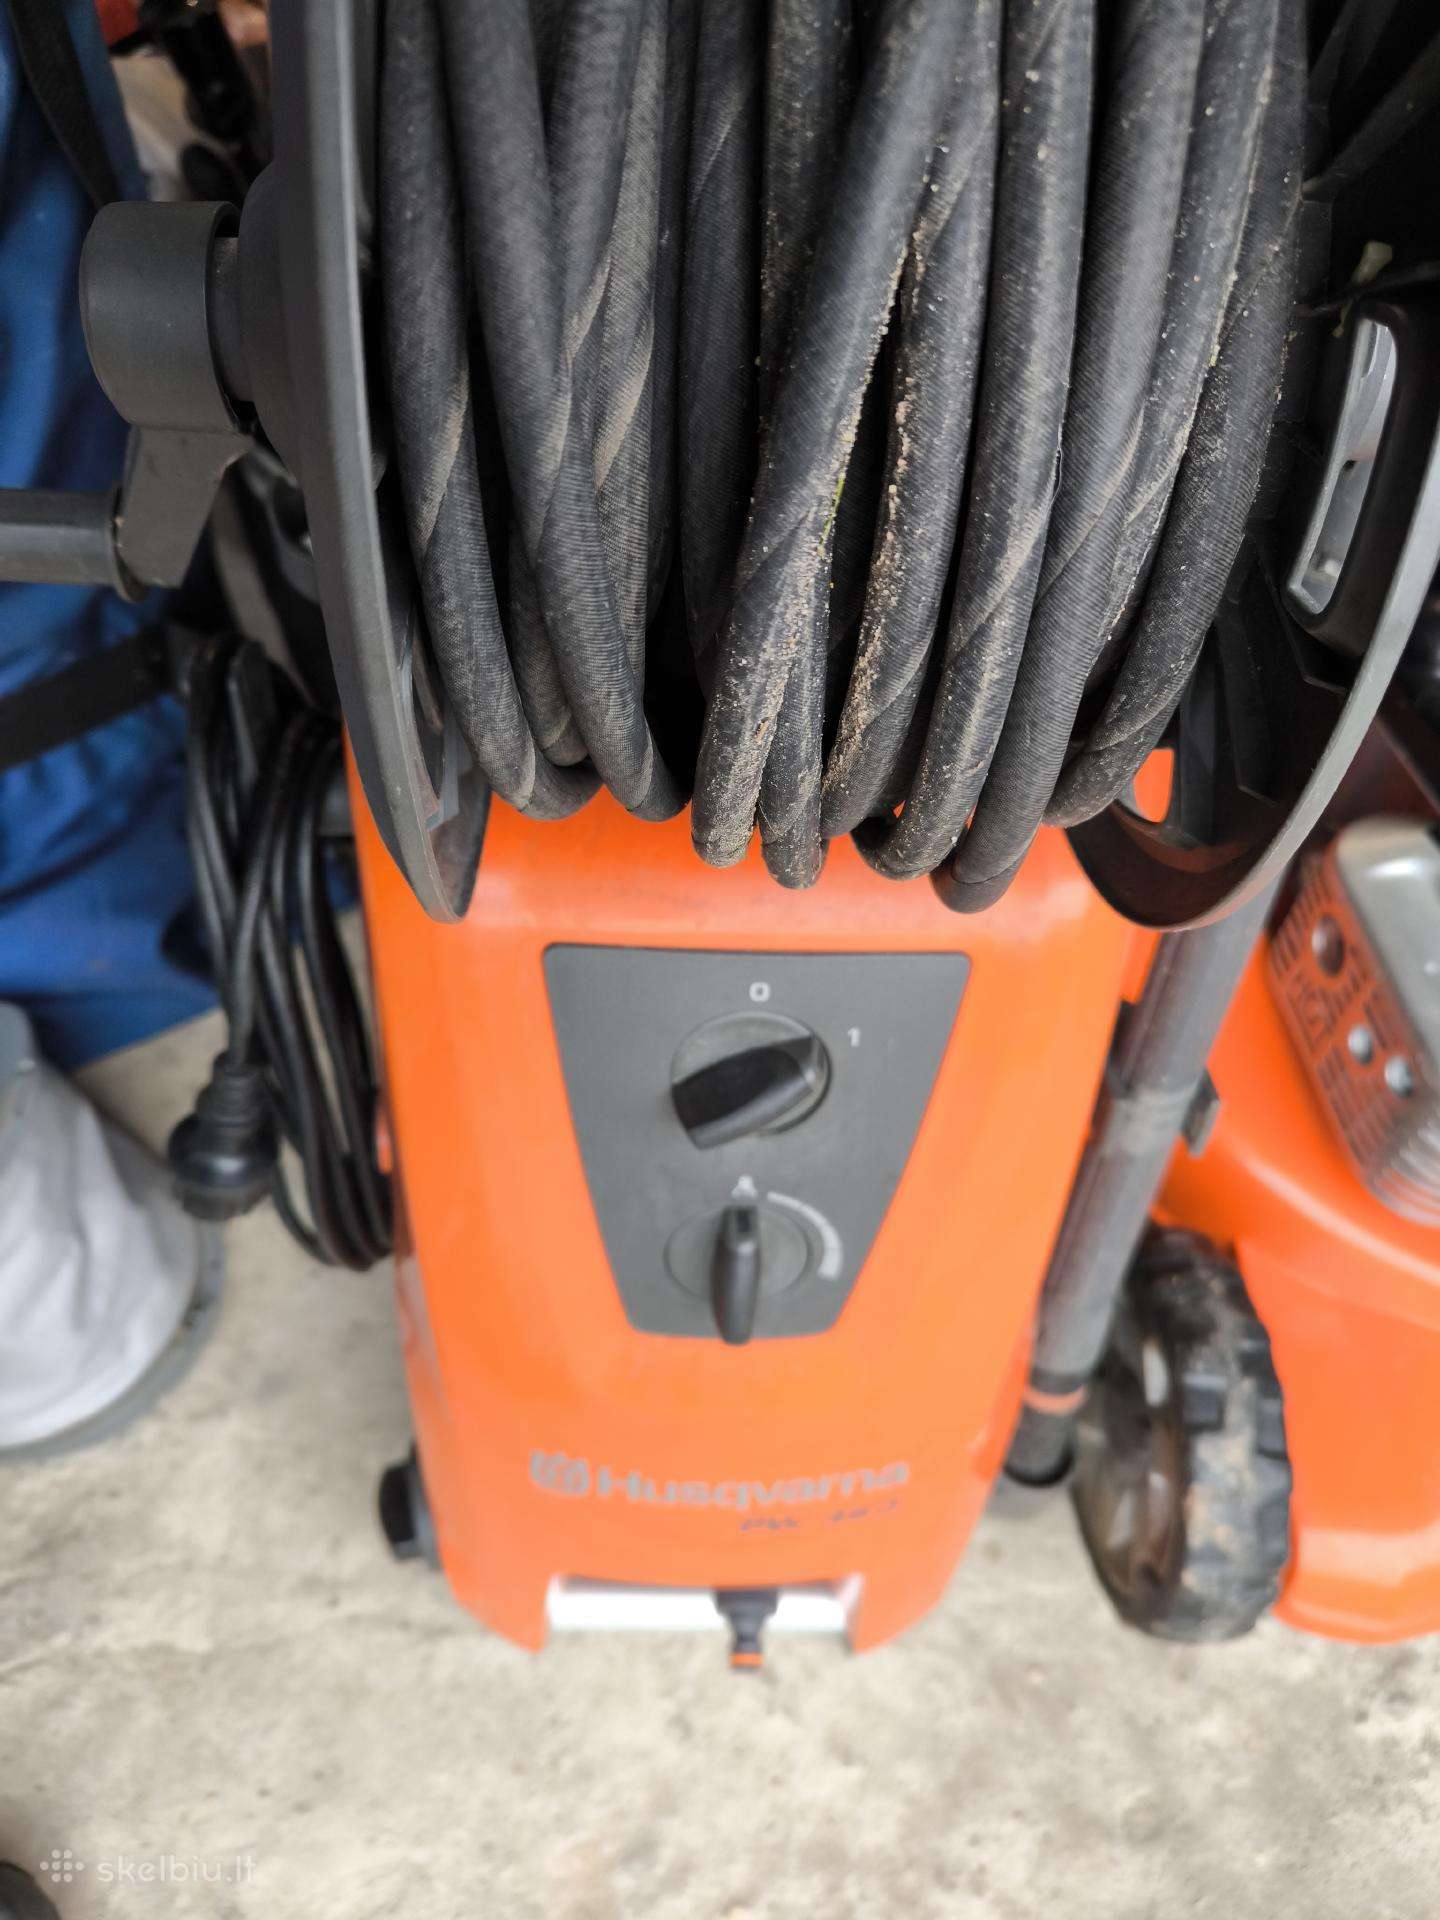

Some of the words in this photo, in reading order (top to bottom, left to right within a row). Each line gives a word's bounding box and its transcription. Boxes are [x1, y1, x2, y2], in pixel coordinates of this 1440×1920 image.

[749, 981, 770, 1001] 0
[847, 1026, 861, 1047] 1
[597, 1461, 911, 1510] Husqvarna
